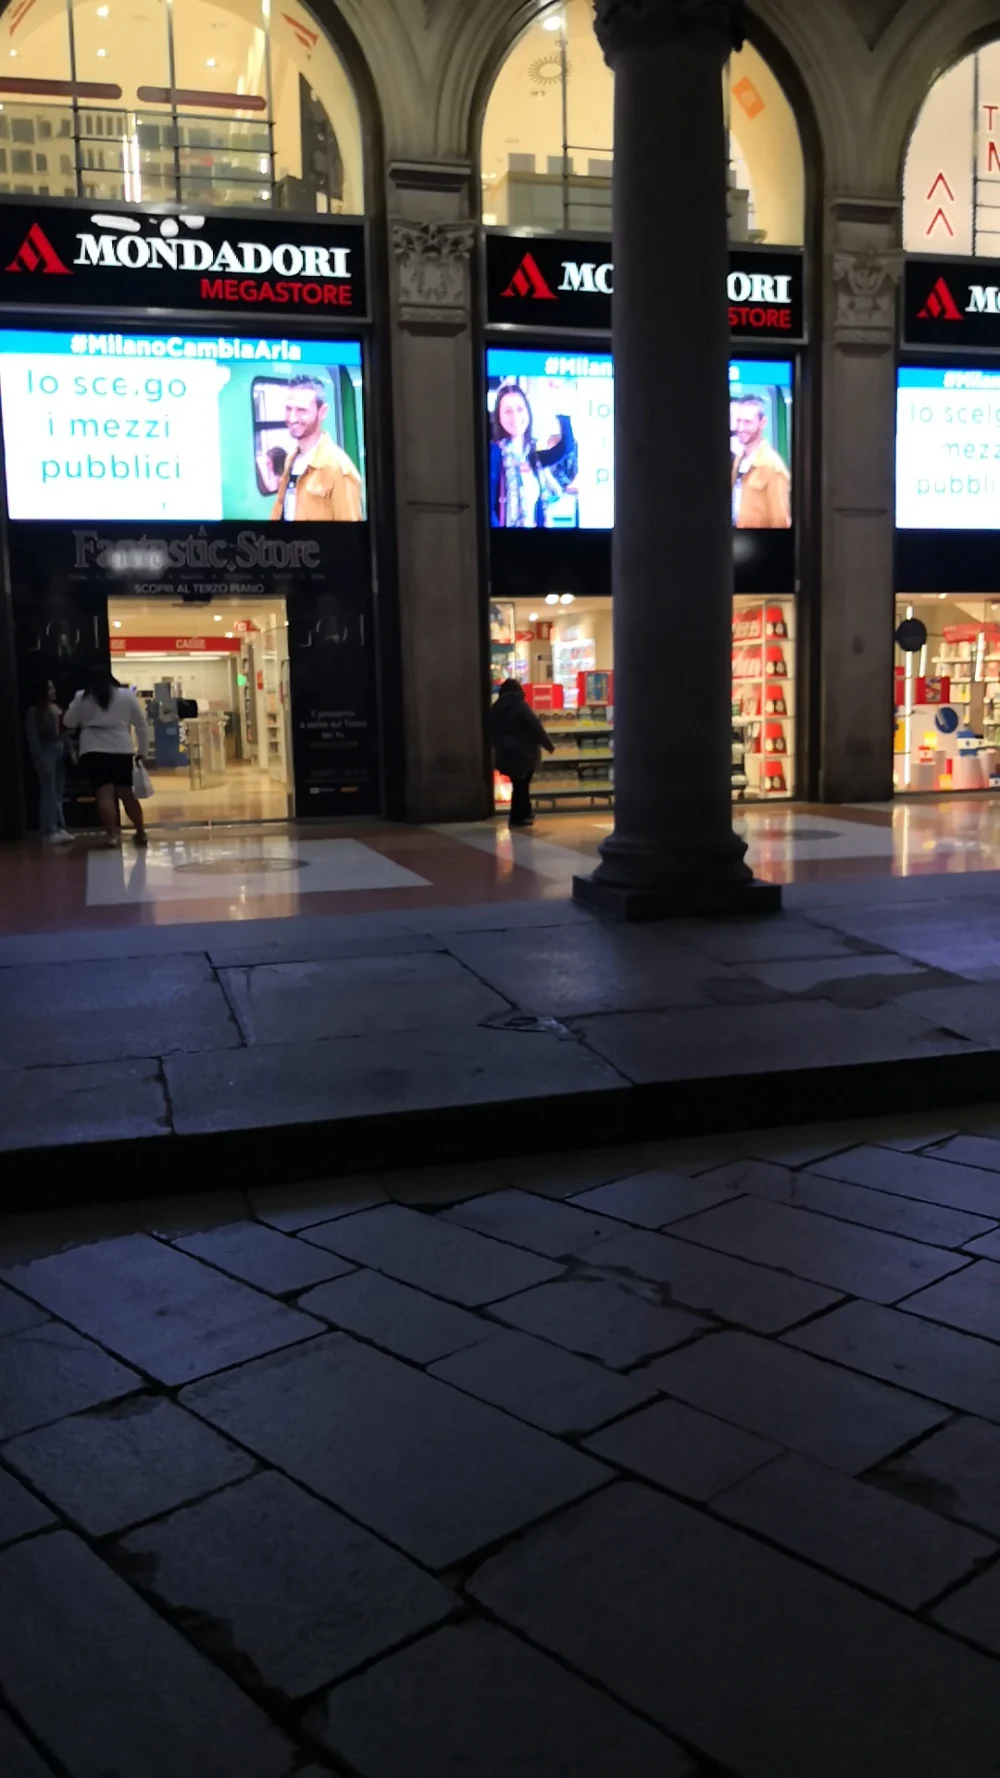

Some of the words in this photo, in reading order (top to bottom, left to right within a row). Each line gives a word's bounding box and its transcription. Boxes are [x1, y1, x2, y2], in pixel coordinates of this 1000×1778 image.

[73, 233, 352, 278] MONDADORI
[200, 278, 353, 305] MEGASTORE
[964, 285, 1000, 314] M
[728, 306, 791, 328] STORE
[70, 414, 170, 438] mezzi
[41, 454, 181, 484] pubblici
[193, 582, 228, 594] TERZO
[229, 582, 265, 594] PIANO
